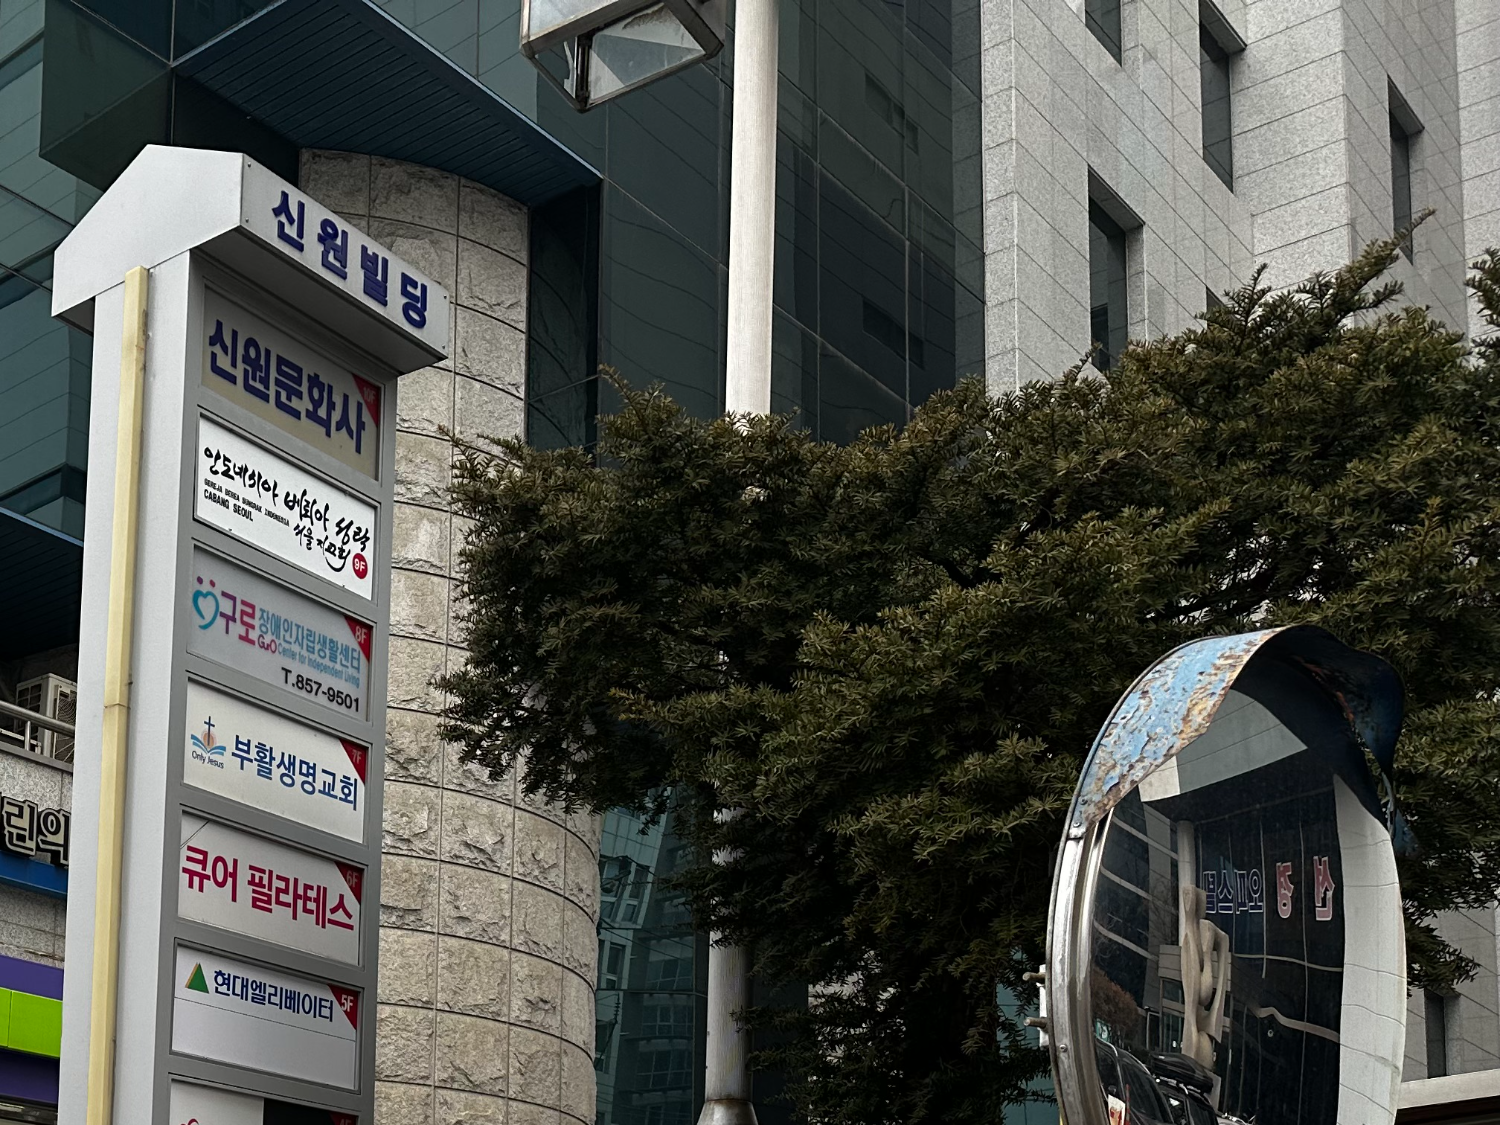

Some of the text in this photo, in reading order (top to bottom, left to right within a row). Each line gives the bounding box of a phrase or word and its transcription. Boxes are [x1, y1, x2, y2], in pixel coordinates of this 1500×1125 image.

[271, 190, 428, 330] 신원빌딩
[208, 318, 366, 455] 신원문화사
[203, 446, 279, 507] 인도네시아
[203, 488, 254, 523] CABANG SEOUL
[353, 557, 367, 573] 9F
[219, 590, 361, 675] 구로 장애인자립생활센터
[355, 625, 368, 644] 8F
[281, 666, 360, 713] T.857-9501
[307, 655, 344, 680] Independent
[344, 668, 361, 689] Living
[191, 750, 225, 769] Only Jesus
[231, 734, 358, 812] 부활생명교회
[182, 844, 355, 931] 큐어 필라테스
[346, 869, 359, 888] 6F
[213, 969, 333, 1022] 현대엘리베이터
[340, 993, 354, 1012] 5F
